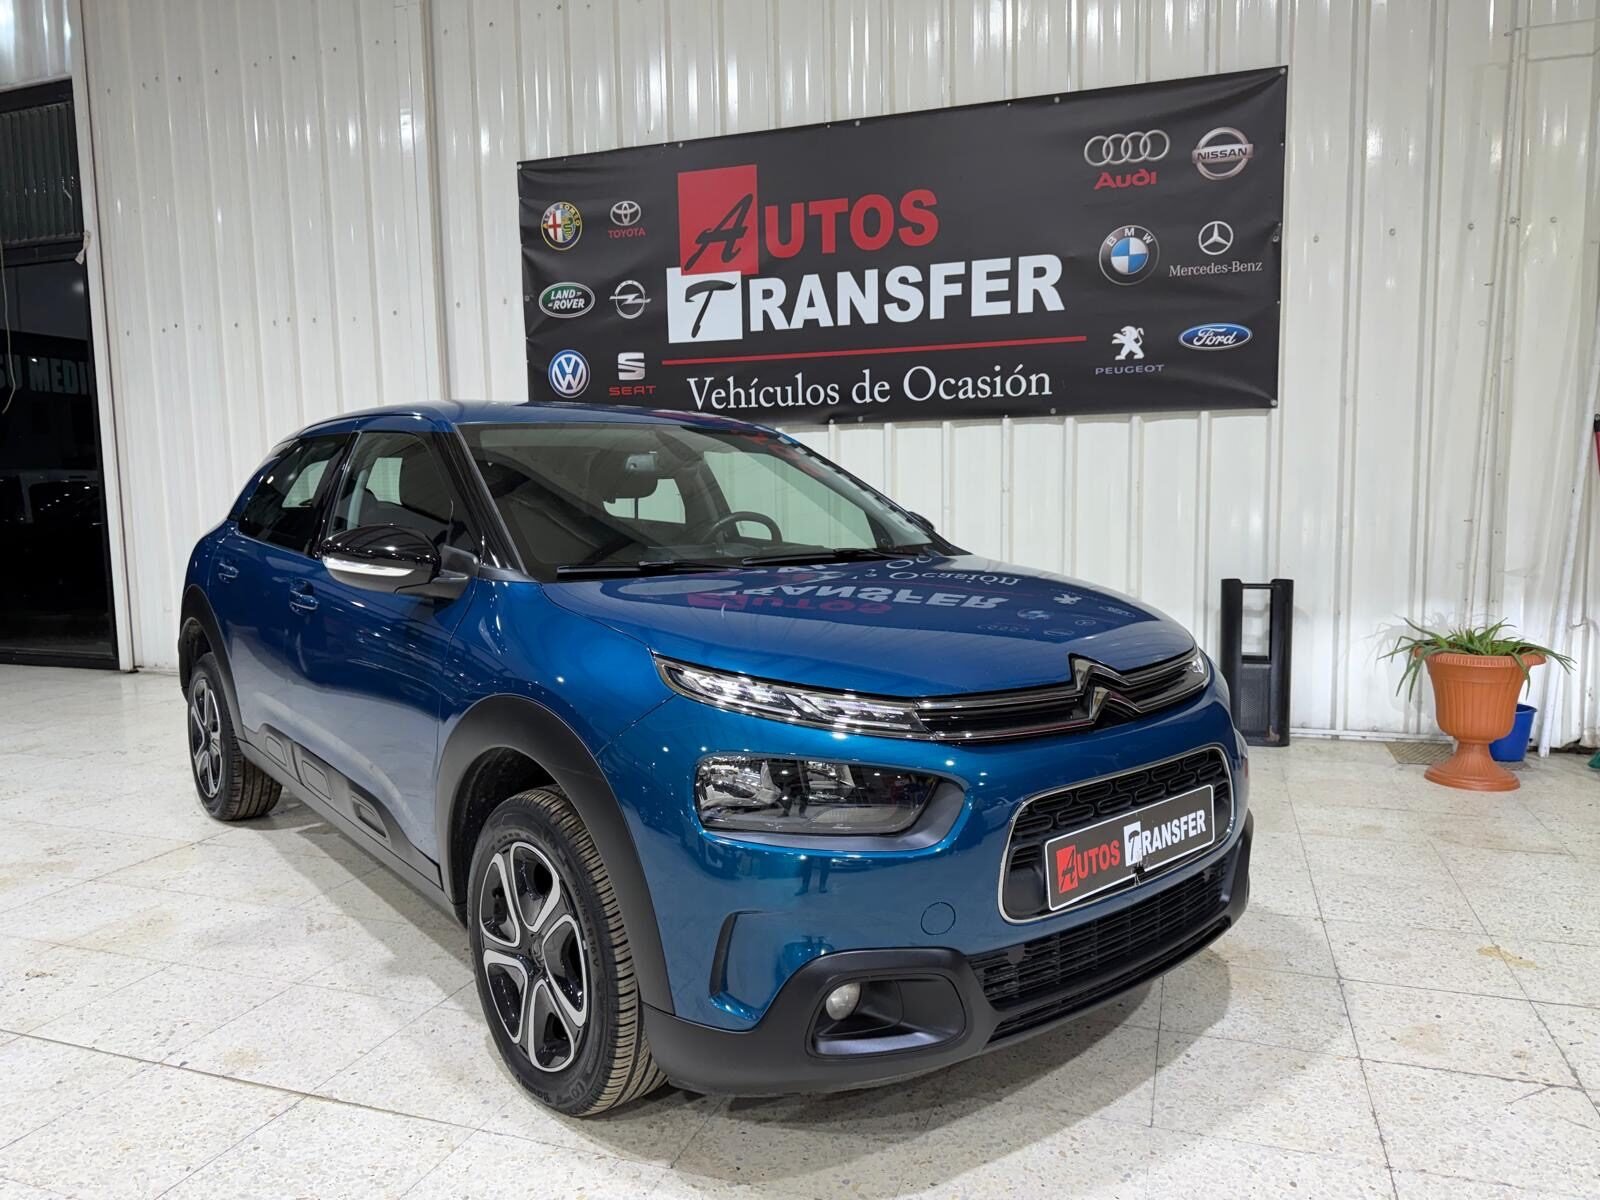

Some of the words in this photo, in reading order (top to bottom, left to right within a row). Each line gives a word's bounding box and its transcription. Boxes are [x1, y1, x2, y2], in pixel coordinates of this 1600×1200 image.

[1197, 147, 1247, 161] NISSAN
[1094, 168, 1157, 190] Audi
[607, 227, 647, 239] TOYOTA
[684, 189, 939, 271] AUTOS
[1106, 227, 1154, 247] BMW
[1169, 260, 1263, 277] Mercedes-Benz
[551, 289, 574, 300] LAND
[685, 253, 1065, 338] TRANSFER
[552, 299, 586, 311] ROVER
[1193, 327, 1237, 347] Ford
[1095, 363, 1166, 375] PEUGEOT
[608, 385, 657, 397] SEAT
[686, 371, 840, 410] Vehículos
[851, 368, 891, 404] de
[902, 364, 1053, 402] Ocasión
[1057, 839, 1121, 893] AUTOS
[1124, 808, 1207, 866] TRANSFER
